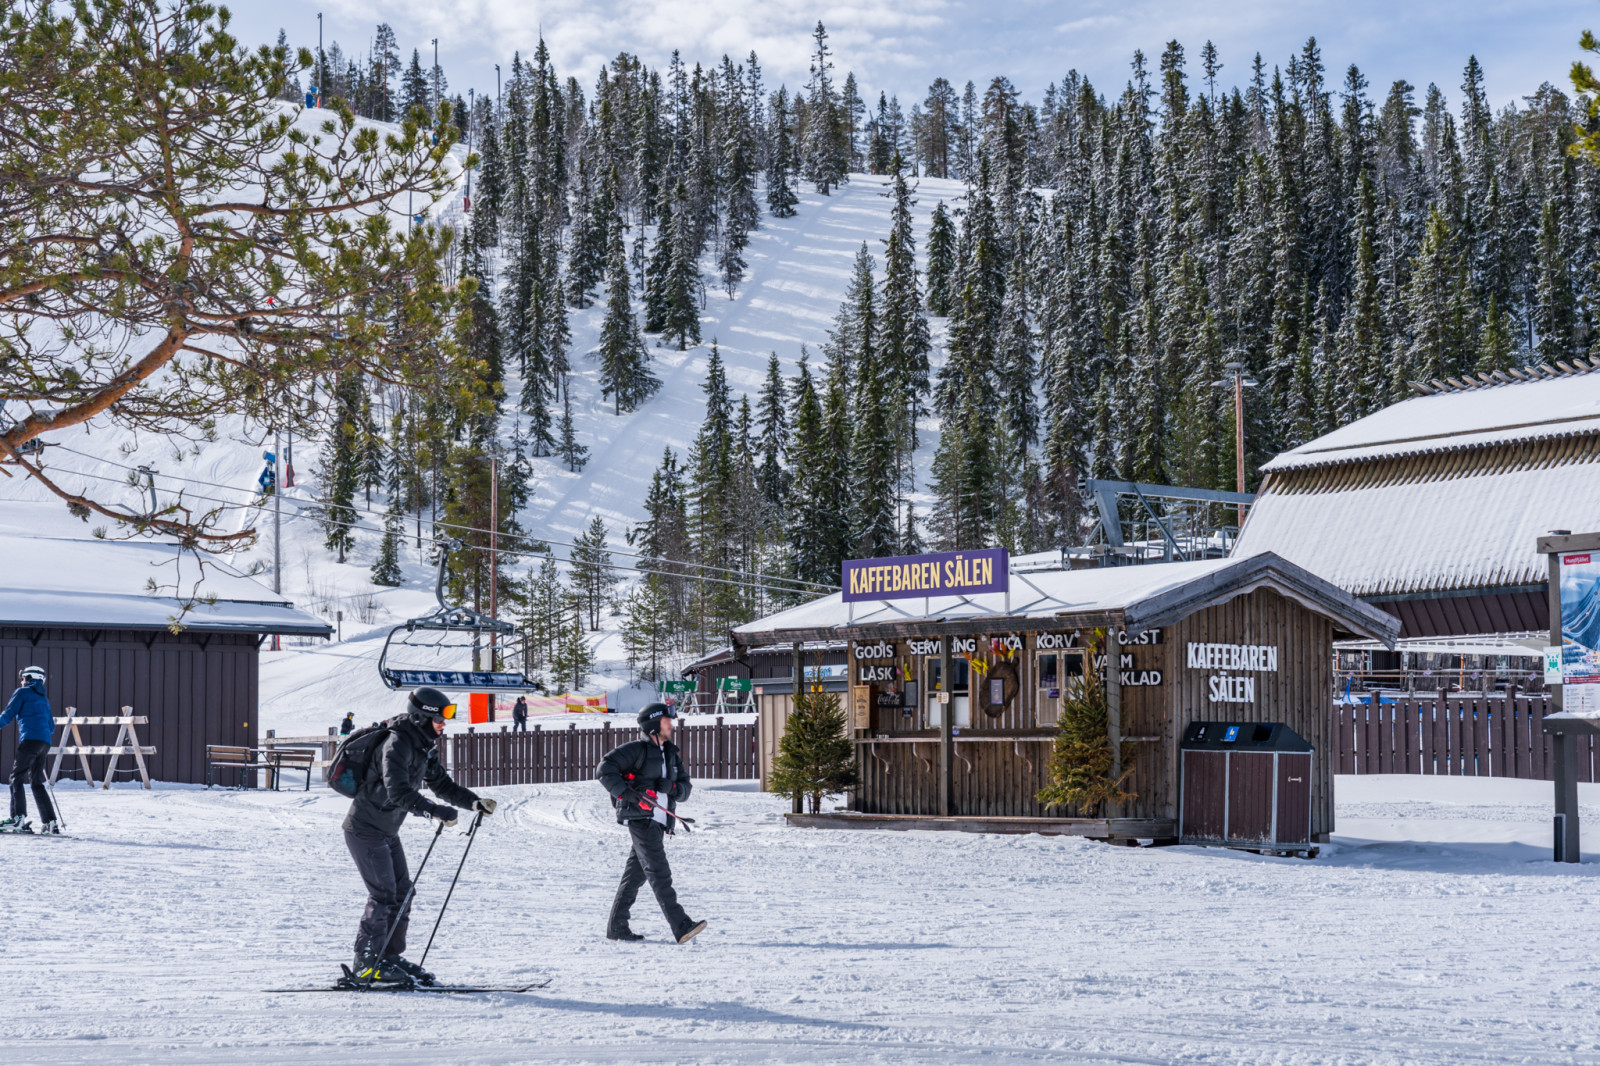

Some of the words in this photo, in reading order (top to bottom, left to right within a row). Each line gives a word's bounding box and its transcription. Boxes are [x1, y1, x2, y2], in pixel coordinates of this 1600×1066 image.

[850, 561, 940, 594] KAFFEBAREN
[944, 555, 993, 588] SÄLEN
[910, 638, 976, 655] SERVING
[1036, 633, 1075, 649] KORV
[855, 644, 894, 660] GODIS
[1187, 642, 1278, 672] KAFFEBAREN
[1094, 653, 1133, 669] VAM
[1208, 670, 1255, 703] SÄLEN
